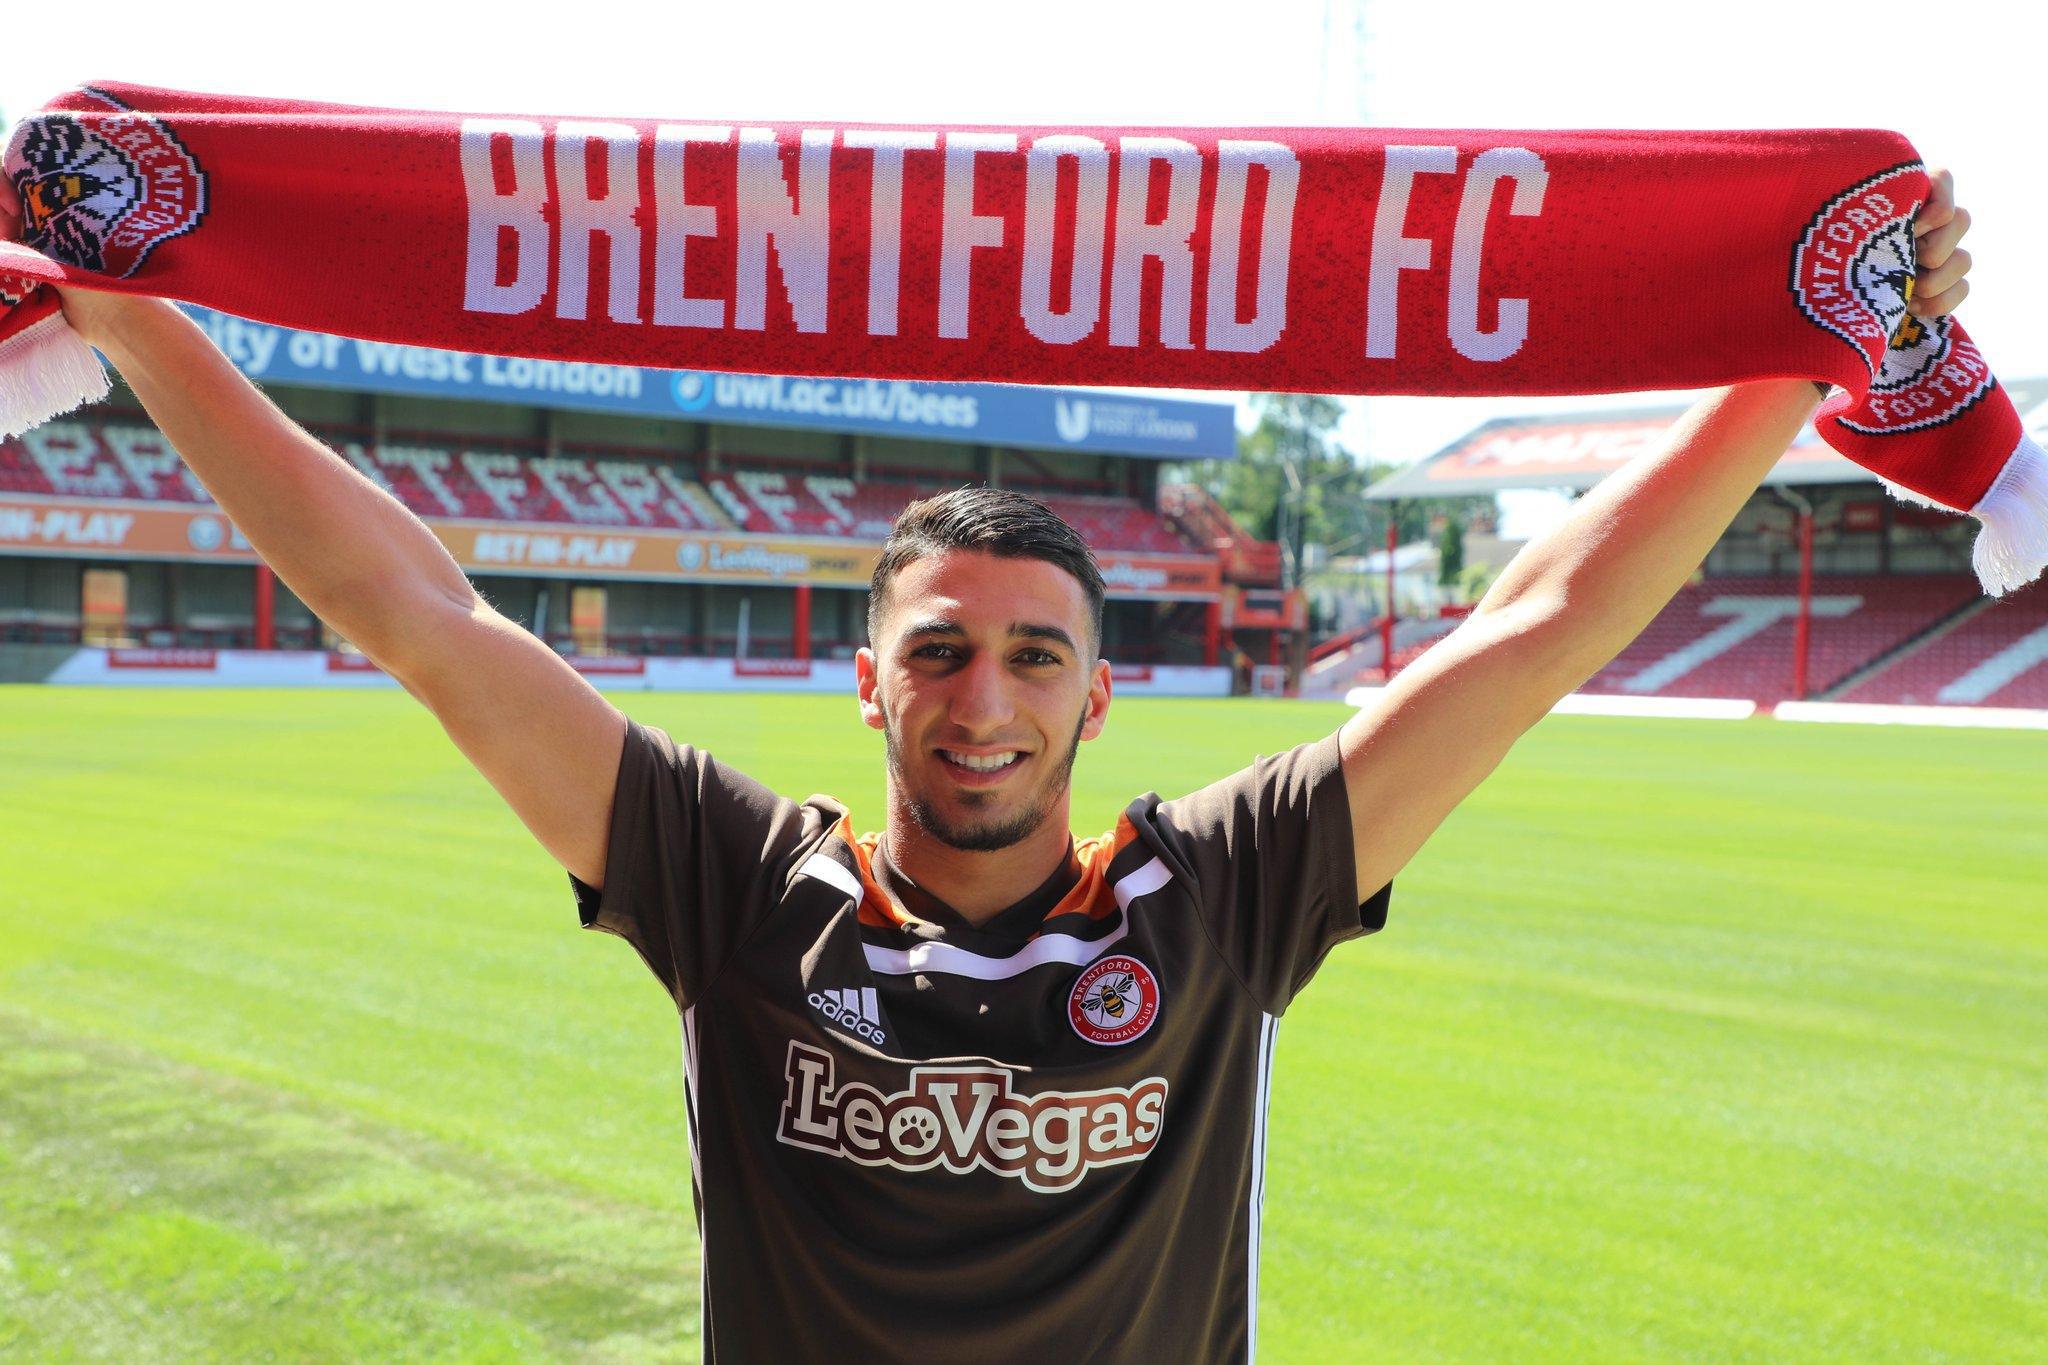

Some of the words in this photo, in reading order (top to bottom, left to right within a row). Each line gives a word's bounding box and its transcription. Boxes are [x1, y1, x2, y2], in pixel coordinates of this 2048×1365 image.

[460, 118, 1301, 353] BRENTFORD
[1365, 145, 1549, 362] FC
[1812, 193, 1895, 338] BRENTFORD
[288, 332, 345, 370] of
[354, 337, 474, 383] West
[481, 354, 642, 398] London
[714, 373, 979, 428] uwl.ac.uk/bees
[473, 532, 528, 562] BET
[529, 534, 637, 567] IN-PLAY
[1073, 961, 1131, 1000] BRENTFORD
[806, 991, 887, 1046] adidas
[1090, 1026, 1139, 1040] FOOTBALL
[1138, 1002, 1154, 1025] CLUB
[786, 1050, 1165, 1183] LeoVegas
